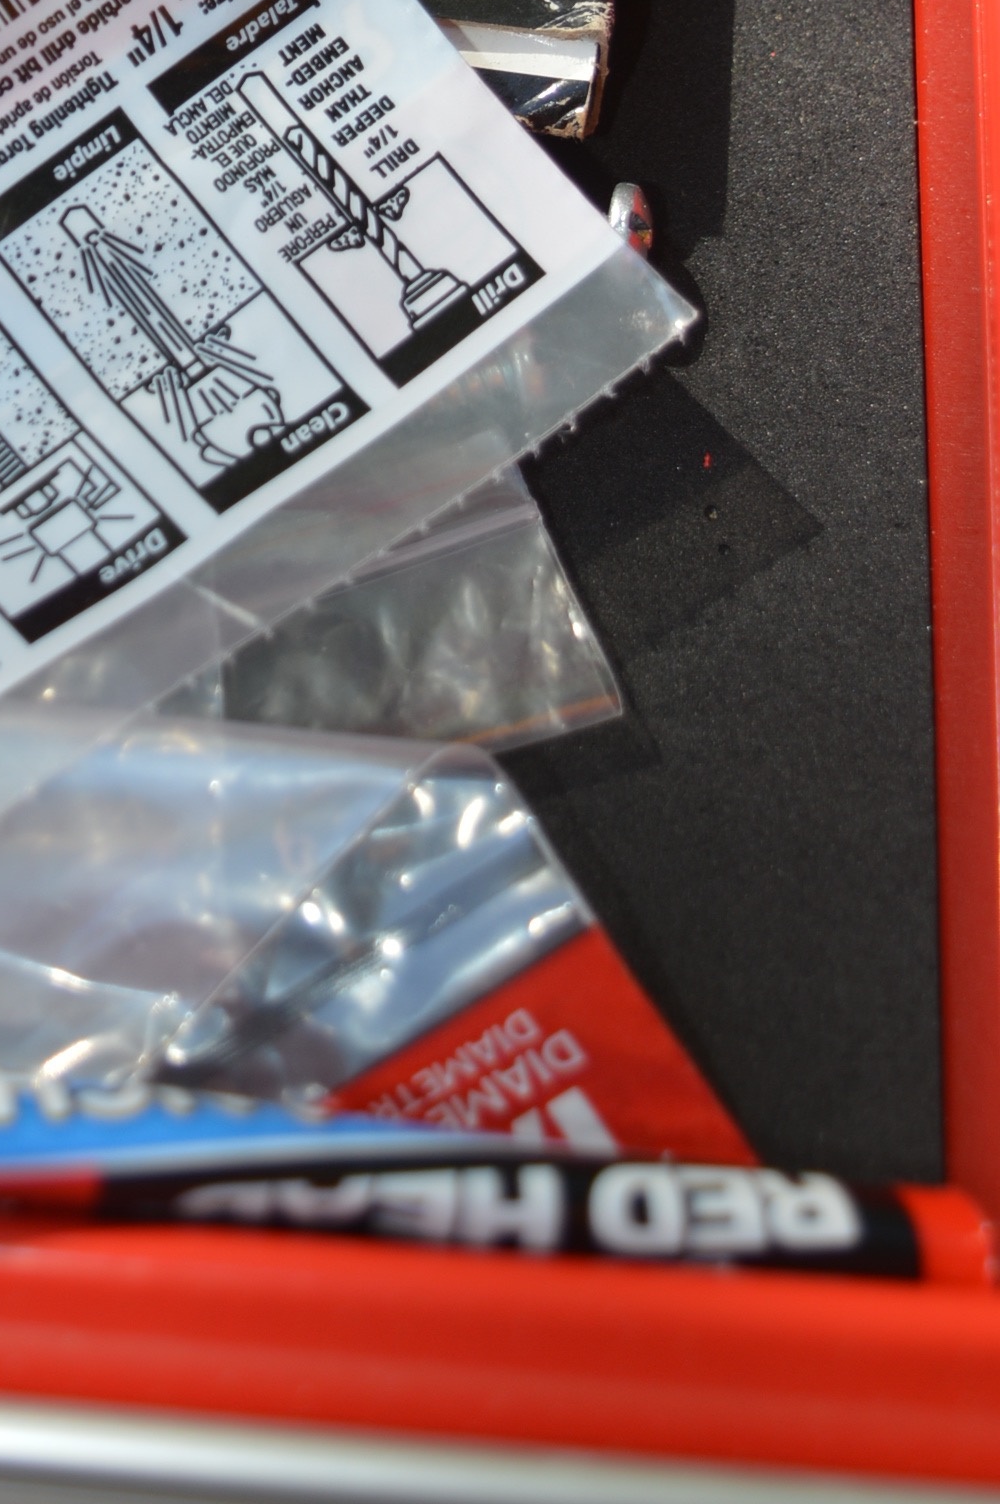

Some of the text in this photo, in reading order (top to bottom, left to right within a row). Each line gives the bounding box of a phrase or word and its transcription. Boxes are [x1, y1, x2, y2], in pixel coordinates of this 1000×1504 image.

[15, 29, 38, 51] de
[36, 8, 67, 35] uso
[39, 28, 78, 66] drill
[121, 2, 185, 67] 1/4"
[276, 22, 327, 67] MENT
[12, 55, 44, 85] bit
[49, 49, 103, 92] Torsión
[283, 35, 350, 89] EMBED-
[296, 53, 365, 112] ANCHOR
[26, 68, 119, 141] Tightening
[31, 84, 53, 105] de
[162, 79, 236, 137] DEL ANCLA
[323, 82, 372, 123] THAN
[184, 101, 236, 145] MIENTO
[189, 109, 257, 162] EMPOTRA-
[330, 94, 396, 148] DEEPER
[50, 122, 122, 182] Limpie
[210, 132, 258, 170] QUE EL
[212, 137, 282, 193] PROFUNDO
[368, 137, 421, 179] DRILL
[253, 183, 313, 233] AGUJERO
[283, 211, 308, 234] UN
[276, 212, 338, 263] PERFORE
[468, 261, 527, 315] Drill
[278, 399, 351, 455] Clean
[96, 526, 169, 585] Drive
[587, 1162, 861, 1254] RED
